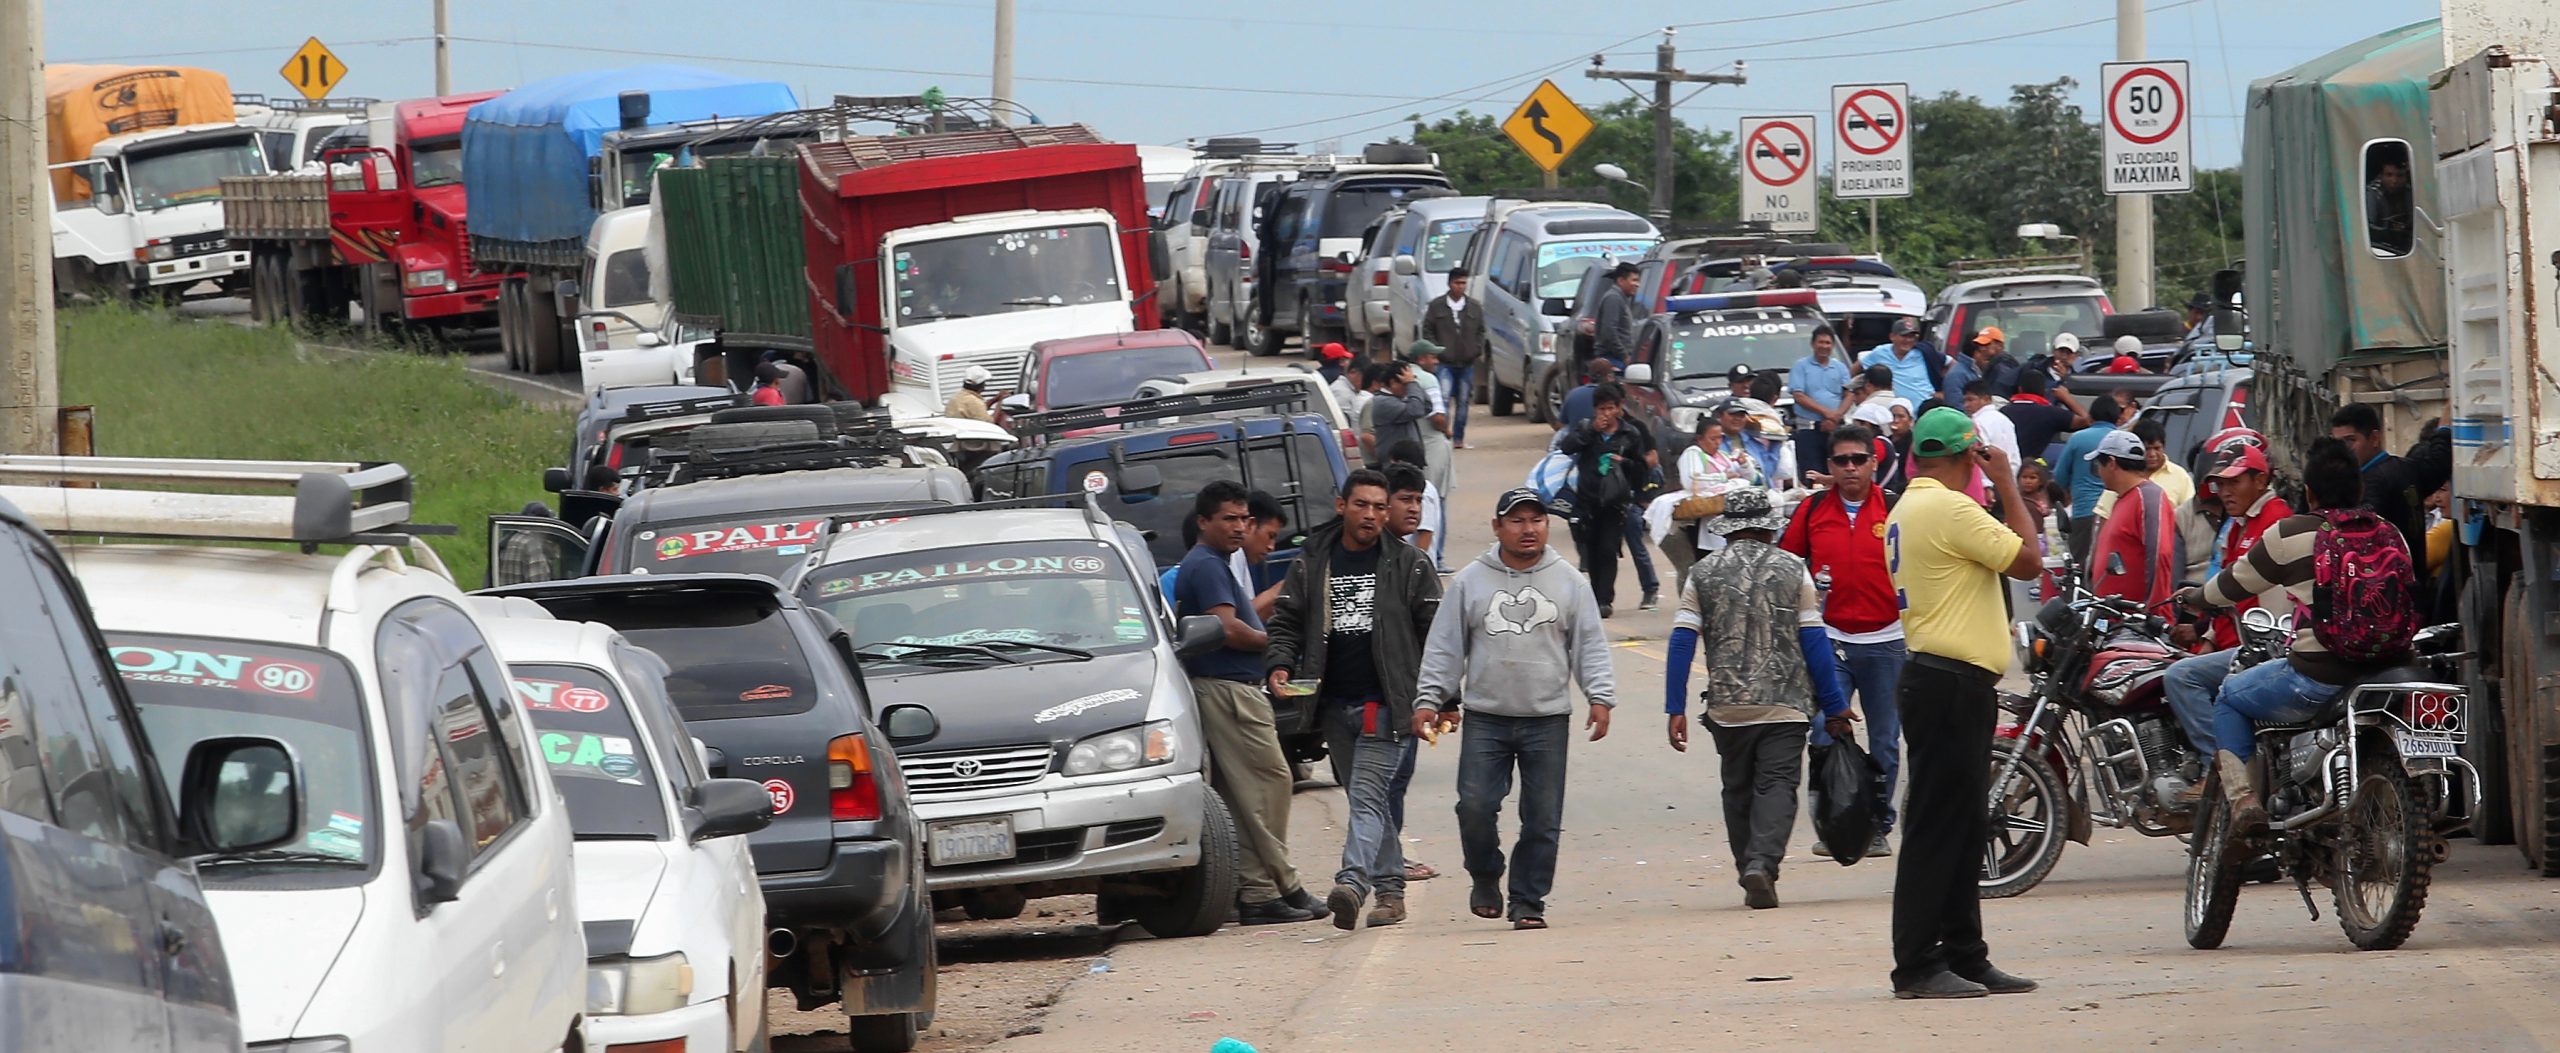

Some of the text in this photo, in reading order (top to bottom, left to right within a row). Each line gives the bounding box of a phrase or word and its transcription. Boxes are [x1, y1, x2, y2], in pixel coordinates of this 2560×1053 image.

[2129, 85, 2162, 114] 50
[2134, 118, 2159, 127] Km/h
[2117, 151, 2179, 165] VELOCIDAD
[1842, 159, 1902, 173] PROHIBIDO
[2114, 166, 2182, 183] MAXIMA
[1840, 177, 1904, 191] ADELANTAR
[1766, 194, 1790, 209] NO
[1571, 244, 1639, 254] TUNAS
[859, 556, 1099, 586] PAILON 56
[201, 678, 238, 689] PL.
[261, 667, 306, 690] 90
[569, 694, 601, 709] 77
[743, 755, 805, 766] COROLLA
